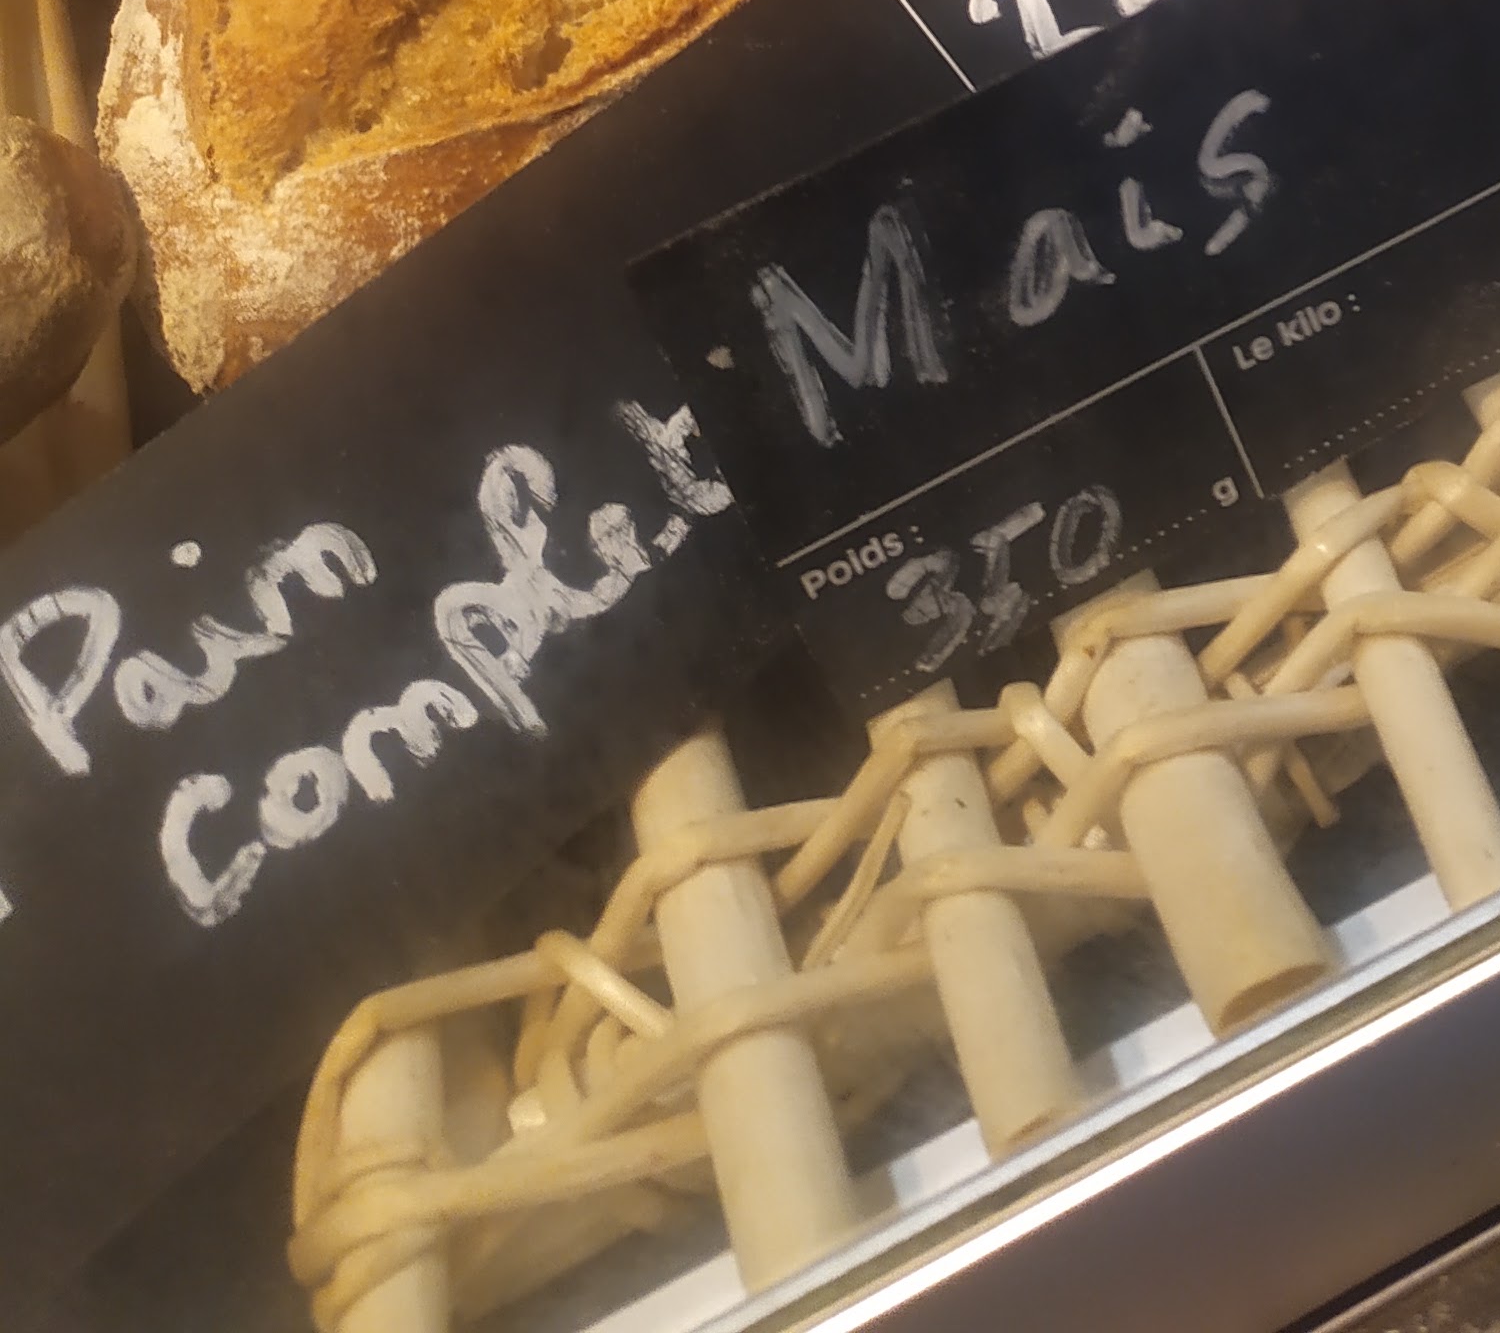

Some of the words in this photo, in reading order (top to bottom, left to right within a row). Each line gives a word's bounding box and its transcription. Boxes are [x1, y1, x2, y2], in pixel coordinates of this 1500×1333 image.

[1233, 340, 1275, 372] Le
[800, 532, 905, 600] Poids
[1212, 476, 1239, 508] g
[0, 522, 378, 775] Pain
